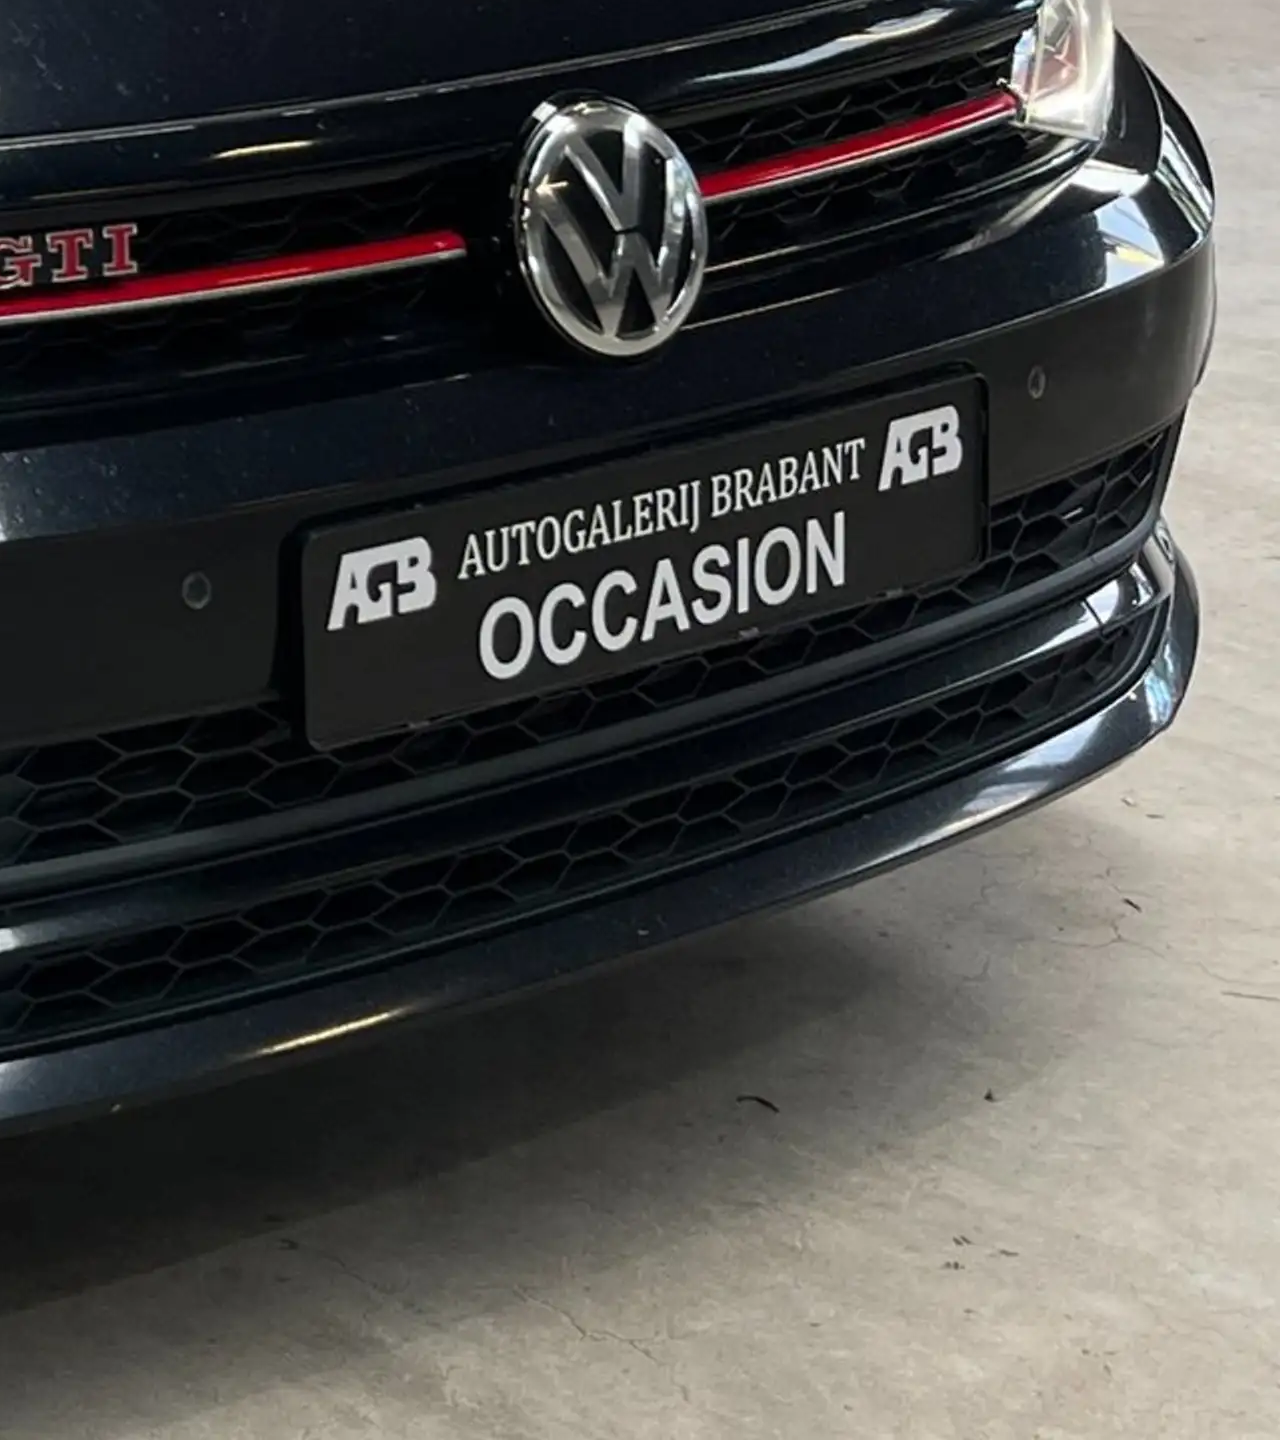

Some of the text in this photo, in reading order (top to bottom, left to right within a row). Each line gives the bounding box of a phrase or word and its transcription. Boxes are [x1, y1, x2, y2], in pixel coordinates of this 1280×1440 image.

[326, 405, 963, 631] AGB AUTOGALERIJ BRABANT AGB
[479, 512, 846, 680] OCCASION
